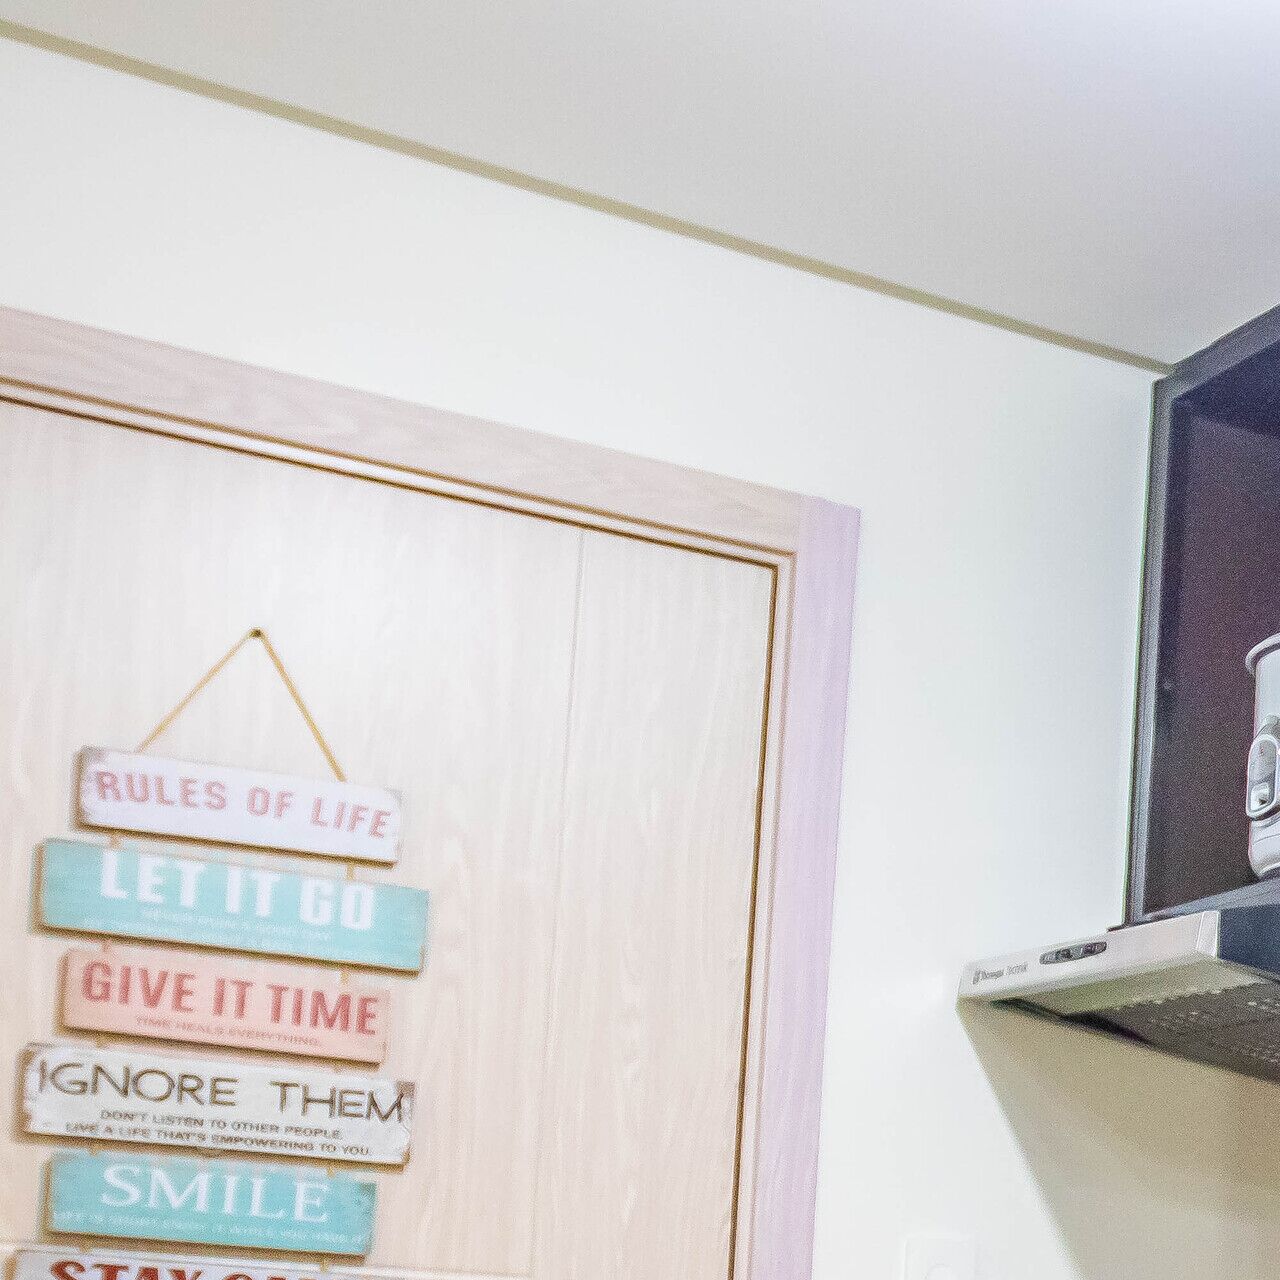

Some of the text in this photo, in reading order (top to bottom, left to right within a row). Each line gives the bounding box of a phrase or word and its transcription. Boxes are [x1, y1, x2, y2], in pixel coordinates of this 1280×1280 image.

[93, 767, 392, 839] RULES OF LIFE
[99, 848, 206, 910] LET
[225, 866, 280, 920] IT
[299, 877, 375, 932] GO
[80, 960, 379, 1036] GIVE IT TIME
[37, 1057, 403, 1125] IGNORE THEM
[100, 1161, 330, 1227] SMILE
